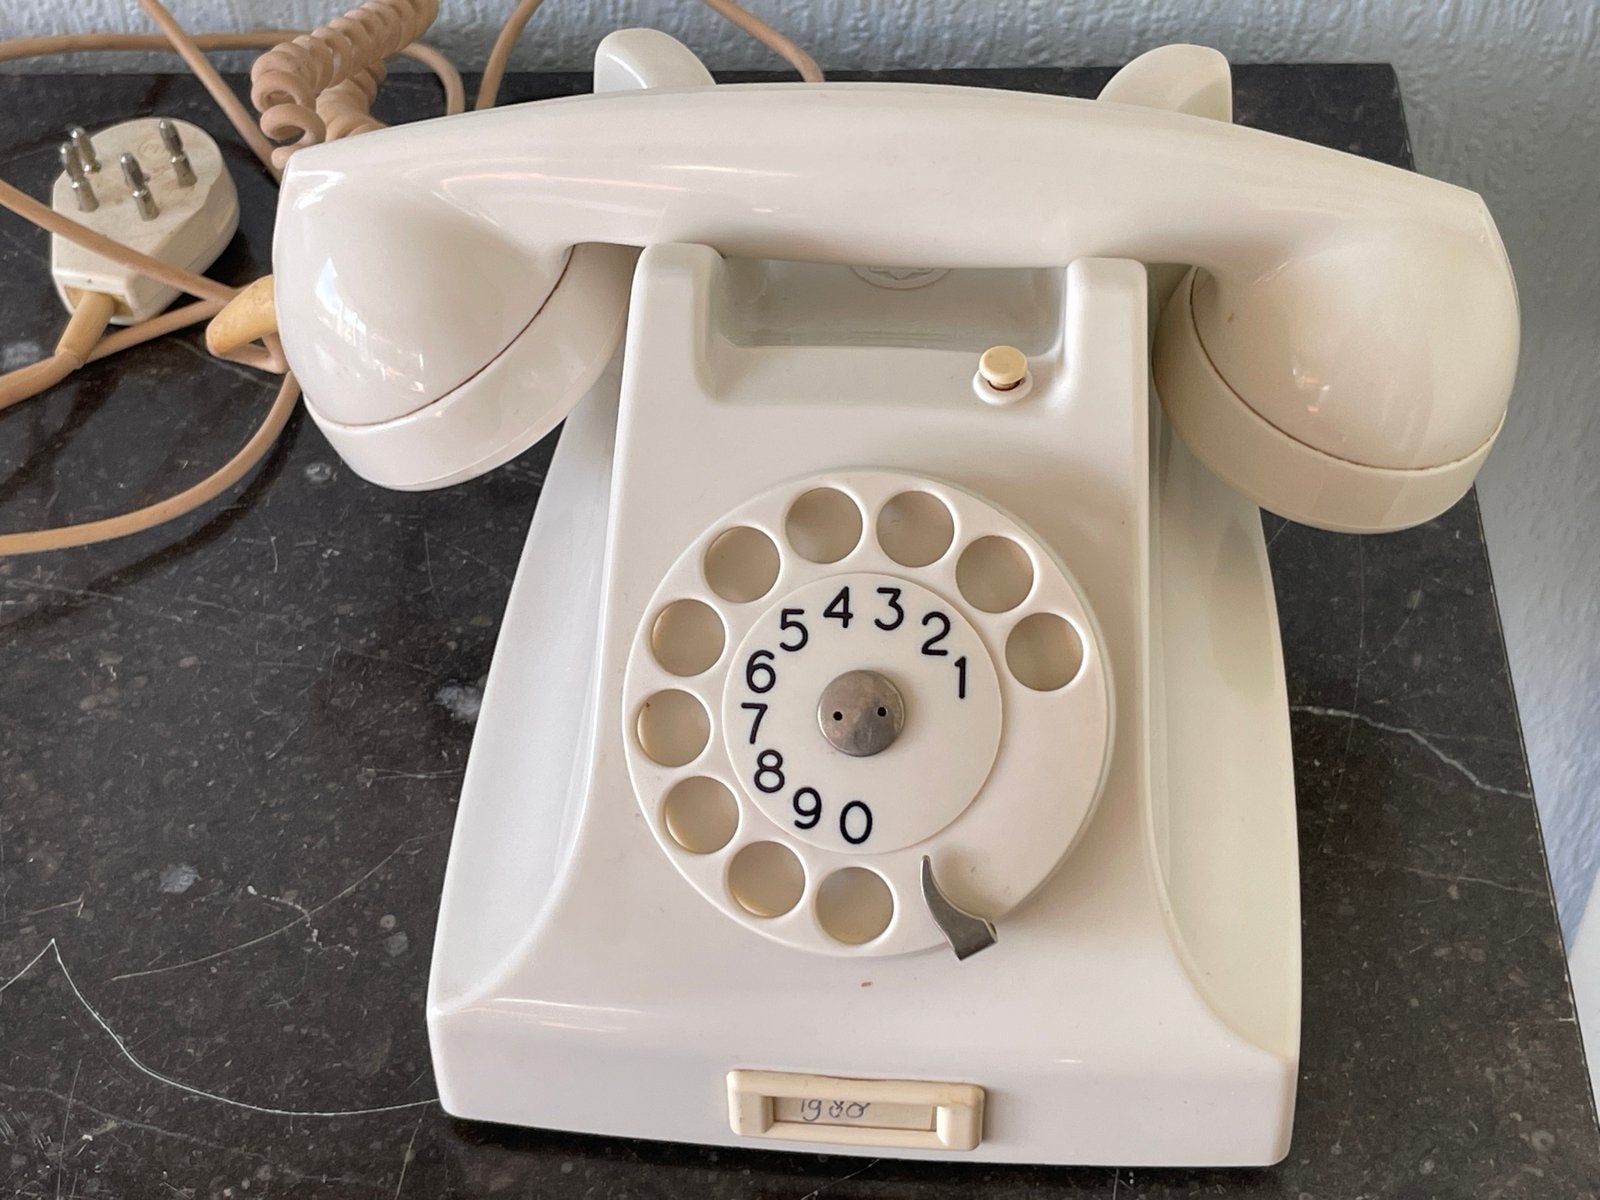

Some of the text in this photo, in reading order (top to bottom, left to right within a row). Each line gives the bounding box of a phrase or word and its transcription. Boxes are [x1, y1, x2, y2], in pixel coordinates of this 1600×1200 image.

[823, 586, 853, 629] 4
[874, 587, 904, 632] 3
[780, 609, 808, 652] 5
[921, 611, 950, 656] 2
[746, 650, 776, 693] 6
[954, 656, 967, 699] 1
[741, 703, 768, 744] 7
[754, 749, 785, 793] 8
[793, 787, 822, 829] 9
[840, 801, 872, 844] 0
